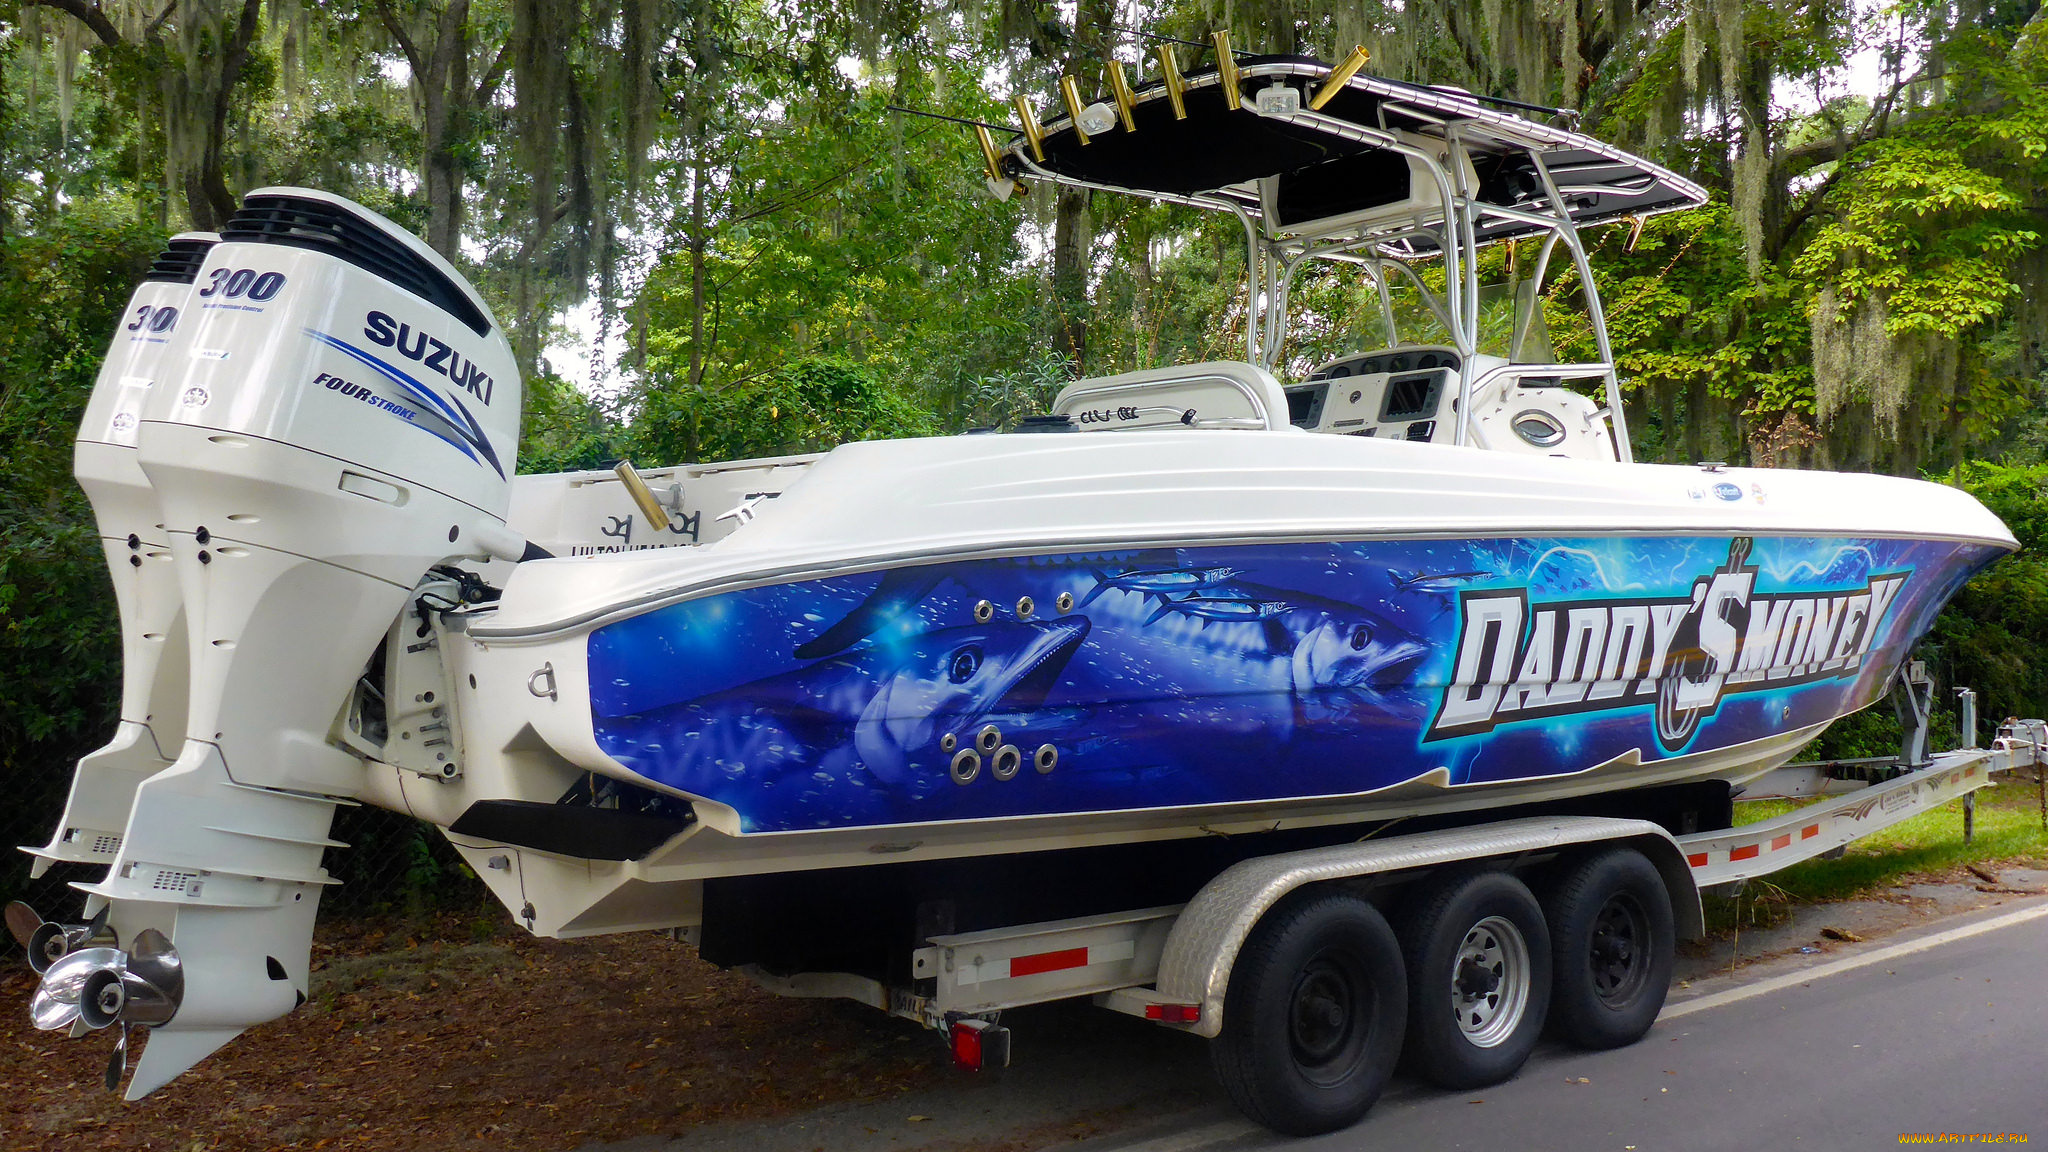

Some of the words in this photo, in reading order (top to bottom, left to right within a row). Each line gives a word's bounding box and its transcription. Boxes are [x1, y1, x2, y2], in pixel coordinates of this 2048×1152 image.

[200, 267, 287, 302] 300
[128, 304, 179, 333] 30
[364, 310, 494, 407] SUZUKI
[1725, 577, 1904, 685] MONEY
